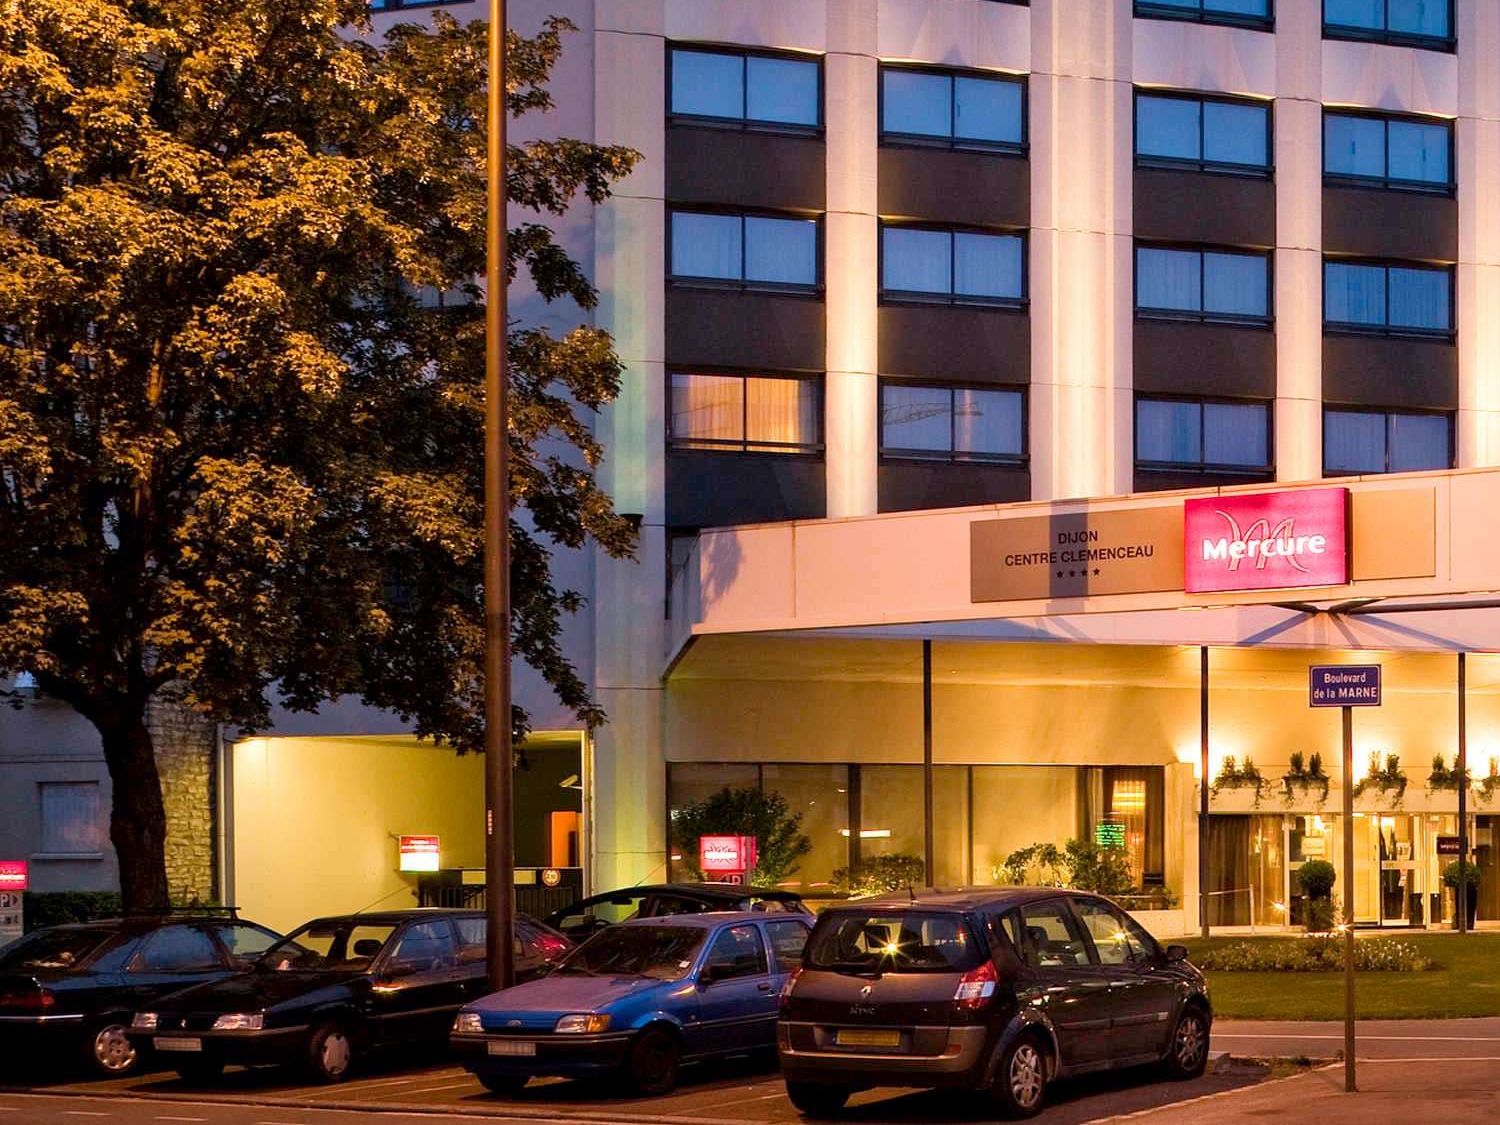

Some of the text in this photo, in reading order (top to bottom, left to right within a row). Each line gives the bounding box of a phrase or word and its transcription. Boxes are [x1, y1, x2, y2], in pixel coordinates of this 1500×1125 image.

[1058, 530, 1098, 544] DIJON
[1202, 533, 1327, 561] Mercure
[1004, 544, 1154, 567] CENTRE CLEMENCEAU
[1323, 671, 1367, 684] Boulevard
[1313, 686, 1377, 699] de la MARNE
